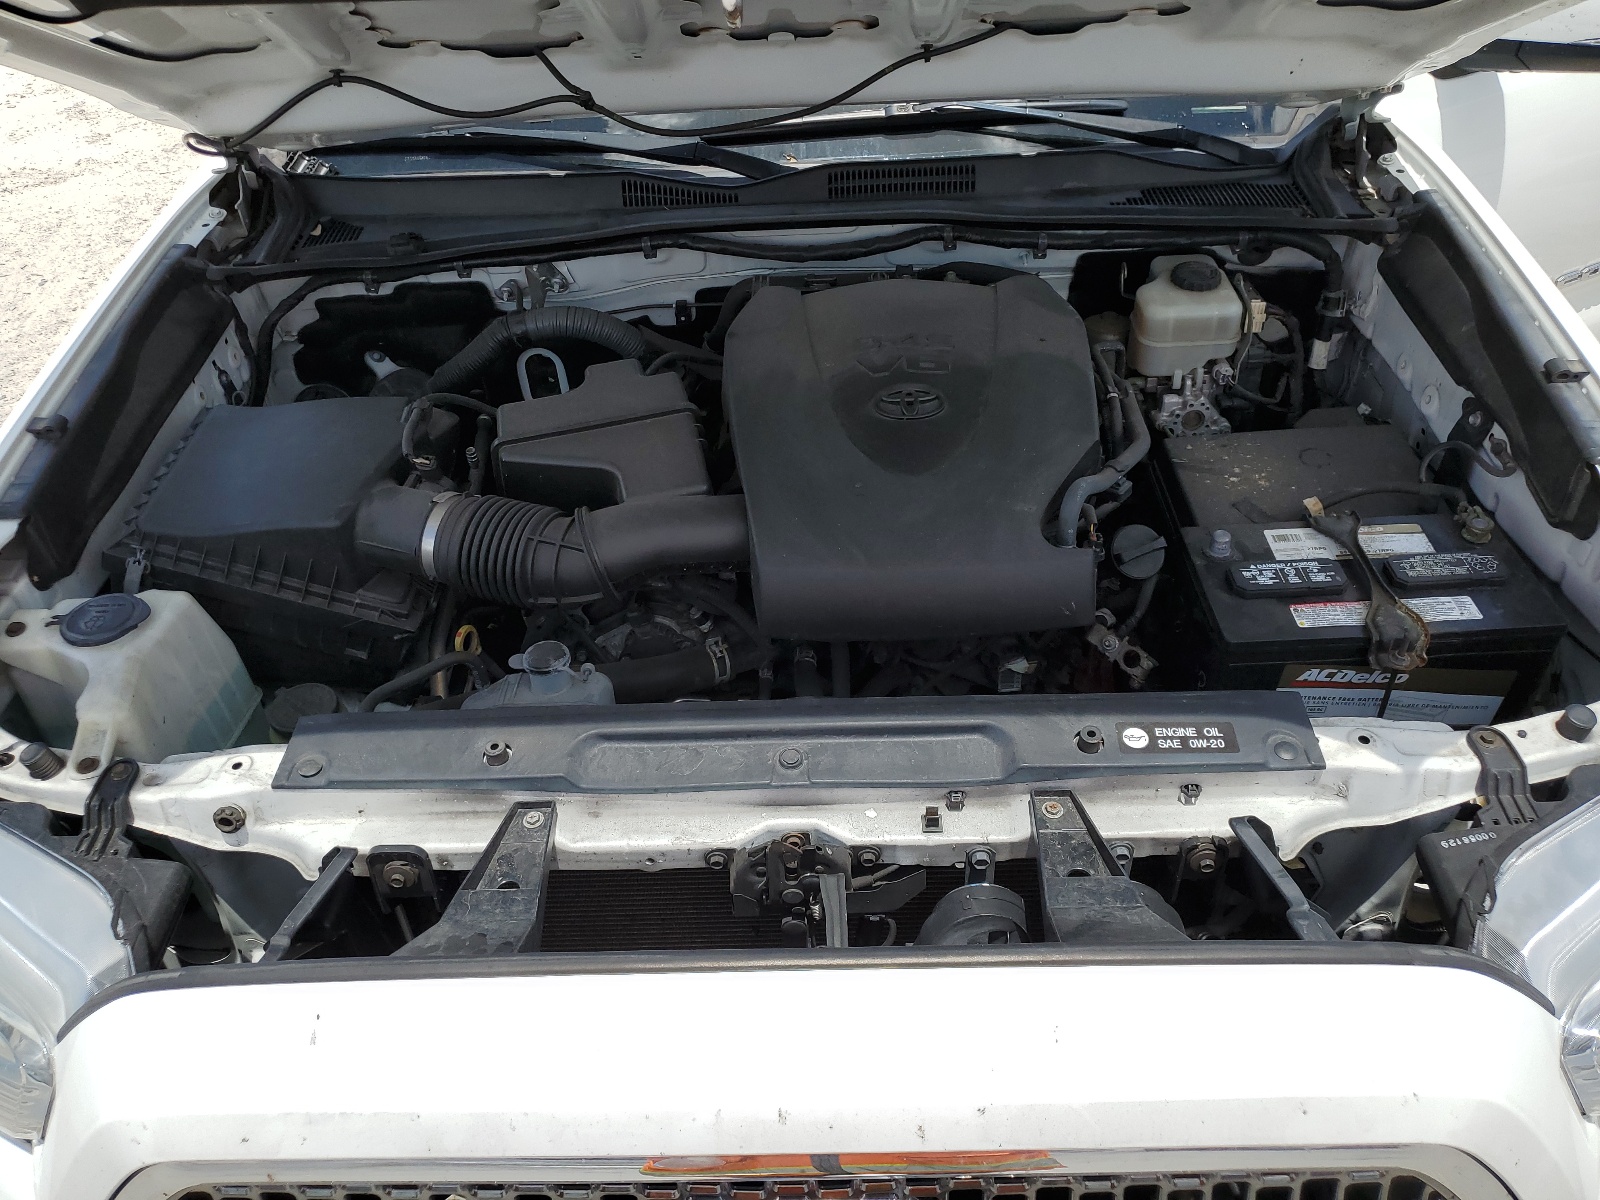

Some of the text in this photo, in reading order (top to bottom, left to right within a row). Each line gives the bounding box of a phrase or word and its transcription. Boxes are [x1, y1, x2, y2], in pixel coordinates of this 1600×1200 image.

[855, 355, 951, 377] V6
[1295, 668, 1410, 684] ACDelco
[1154, 727, 1224, 737] ENGINE OIL
[1157, 739, 1225, 748] SAE 0W-20
